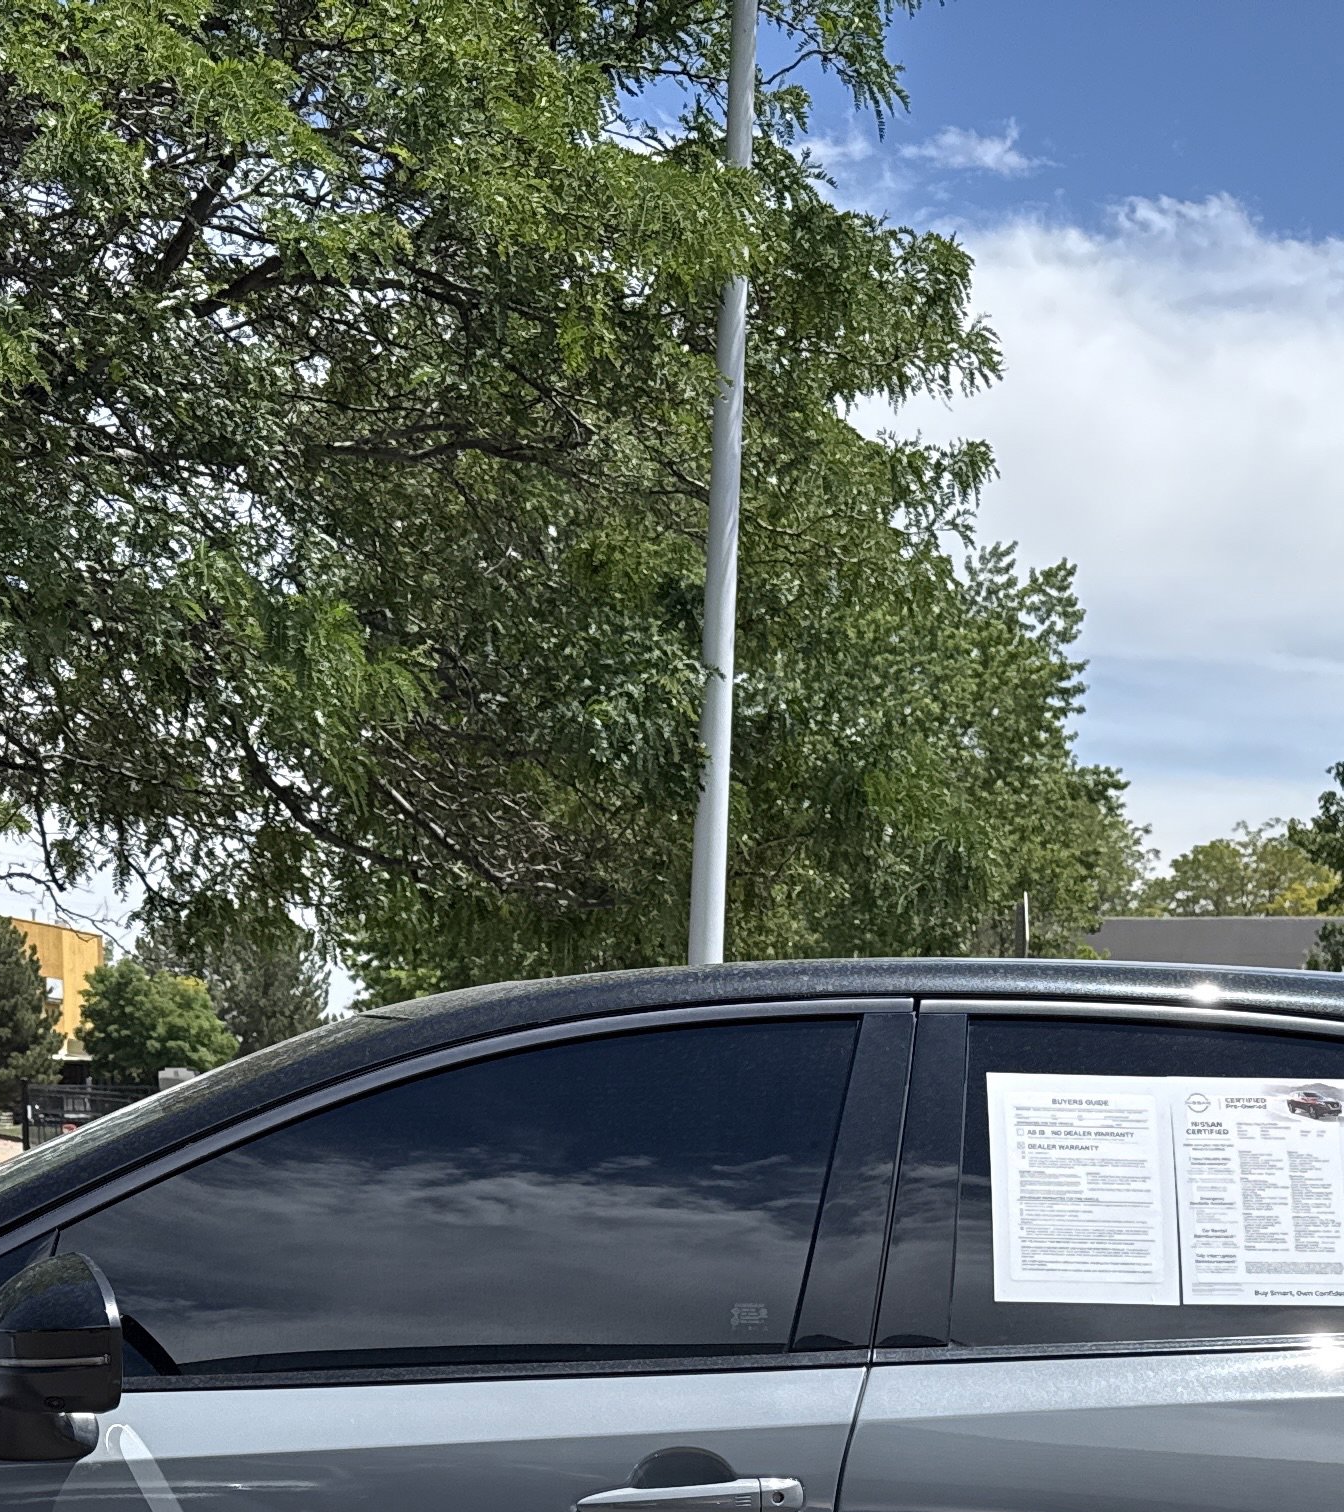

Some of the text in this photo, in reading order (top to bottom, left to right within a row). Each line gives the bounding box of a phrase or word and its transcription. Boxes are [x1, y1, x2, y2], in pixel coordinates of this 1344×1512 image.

[1051, 1098, 1109, 1107] BUYERS GUIDE
[1185, 1128, 1230, 1136] CERTIFIED
[1254, 1289, 1268, 1298] Buy
